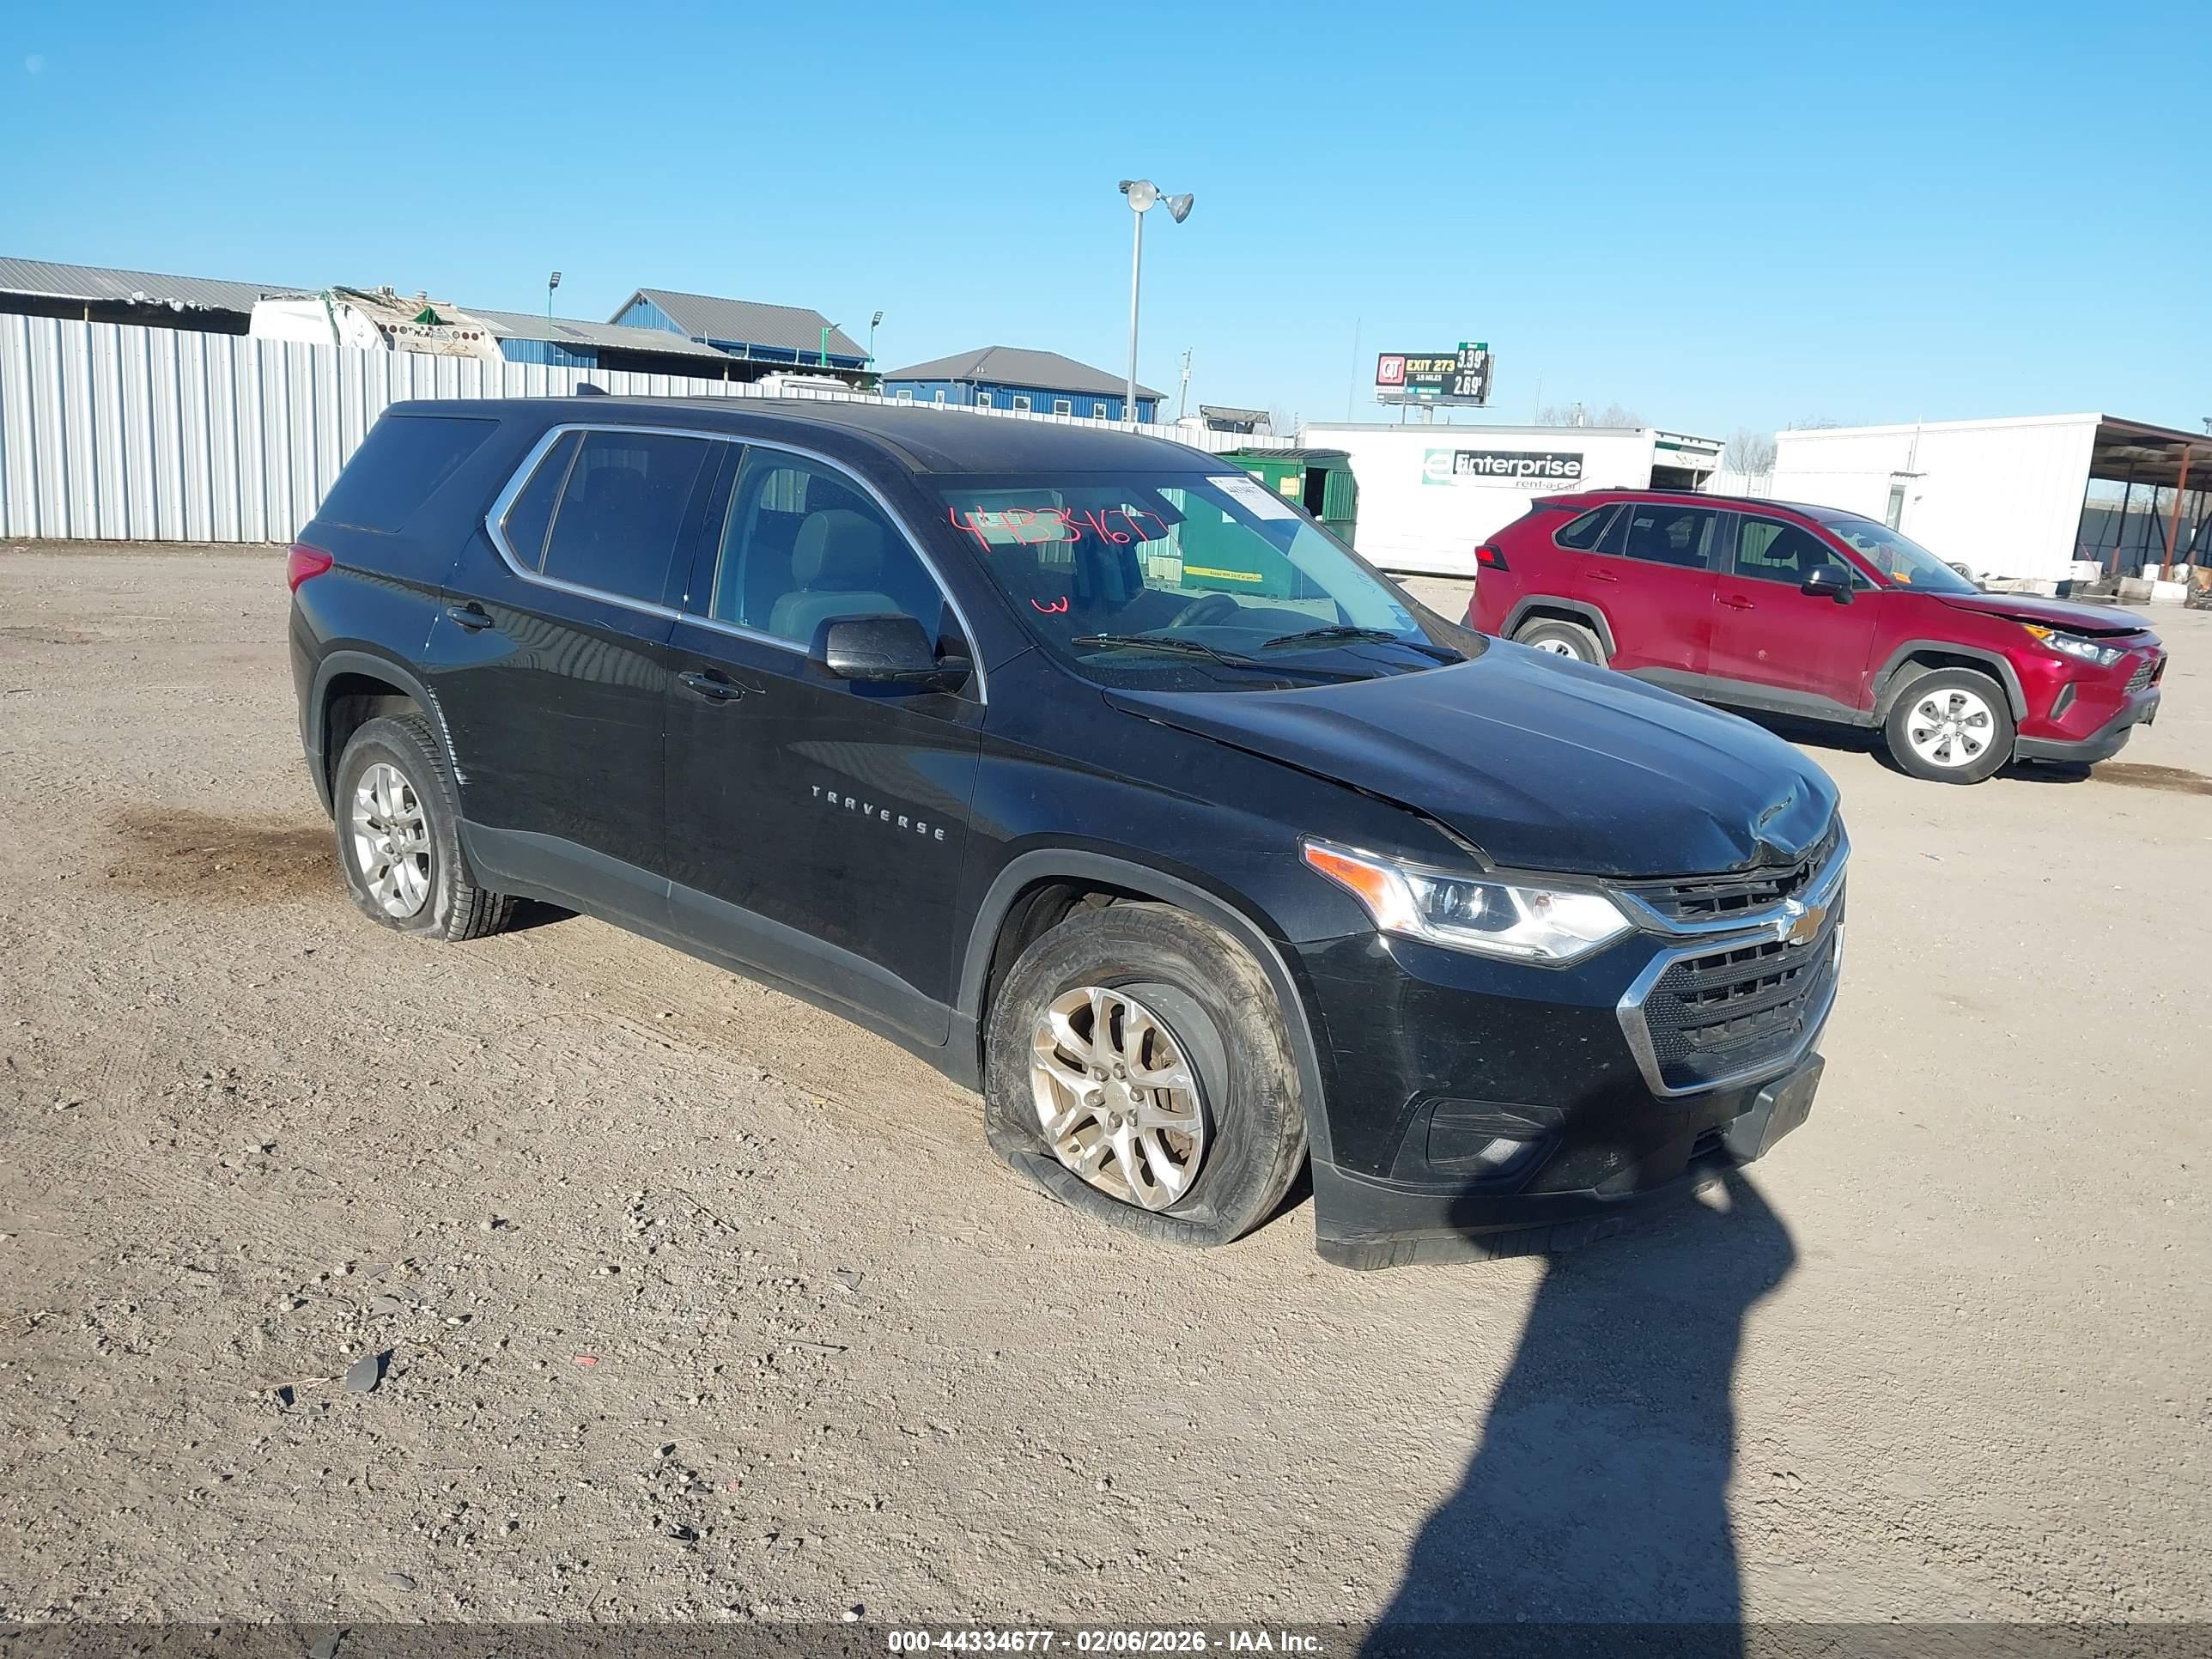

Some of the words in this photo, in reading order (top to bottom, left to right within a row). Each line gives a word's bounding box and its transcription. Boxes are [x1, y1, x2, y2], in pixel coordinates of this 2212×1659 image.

[1406, 359, 1431, 371] EXIT
[1432, 359, 1455, 372] 273
[811, 785, 945, 841] TRAVERSE
